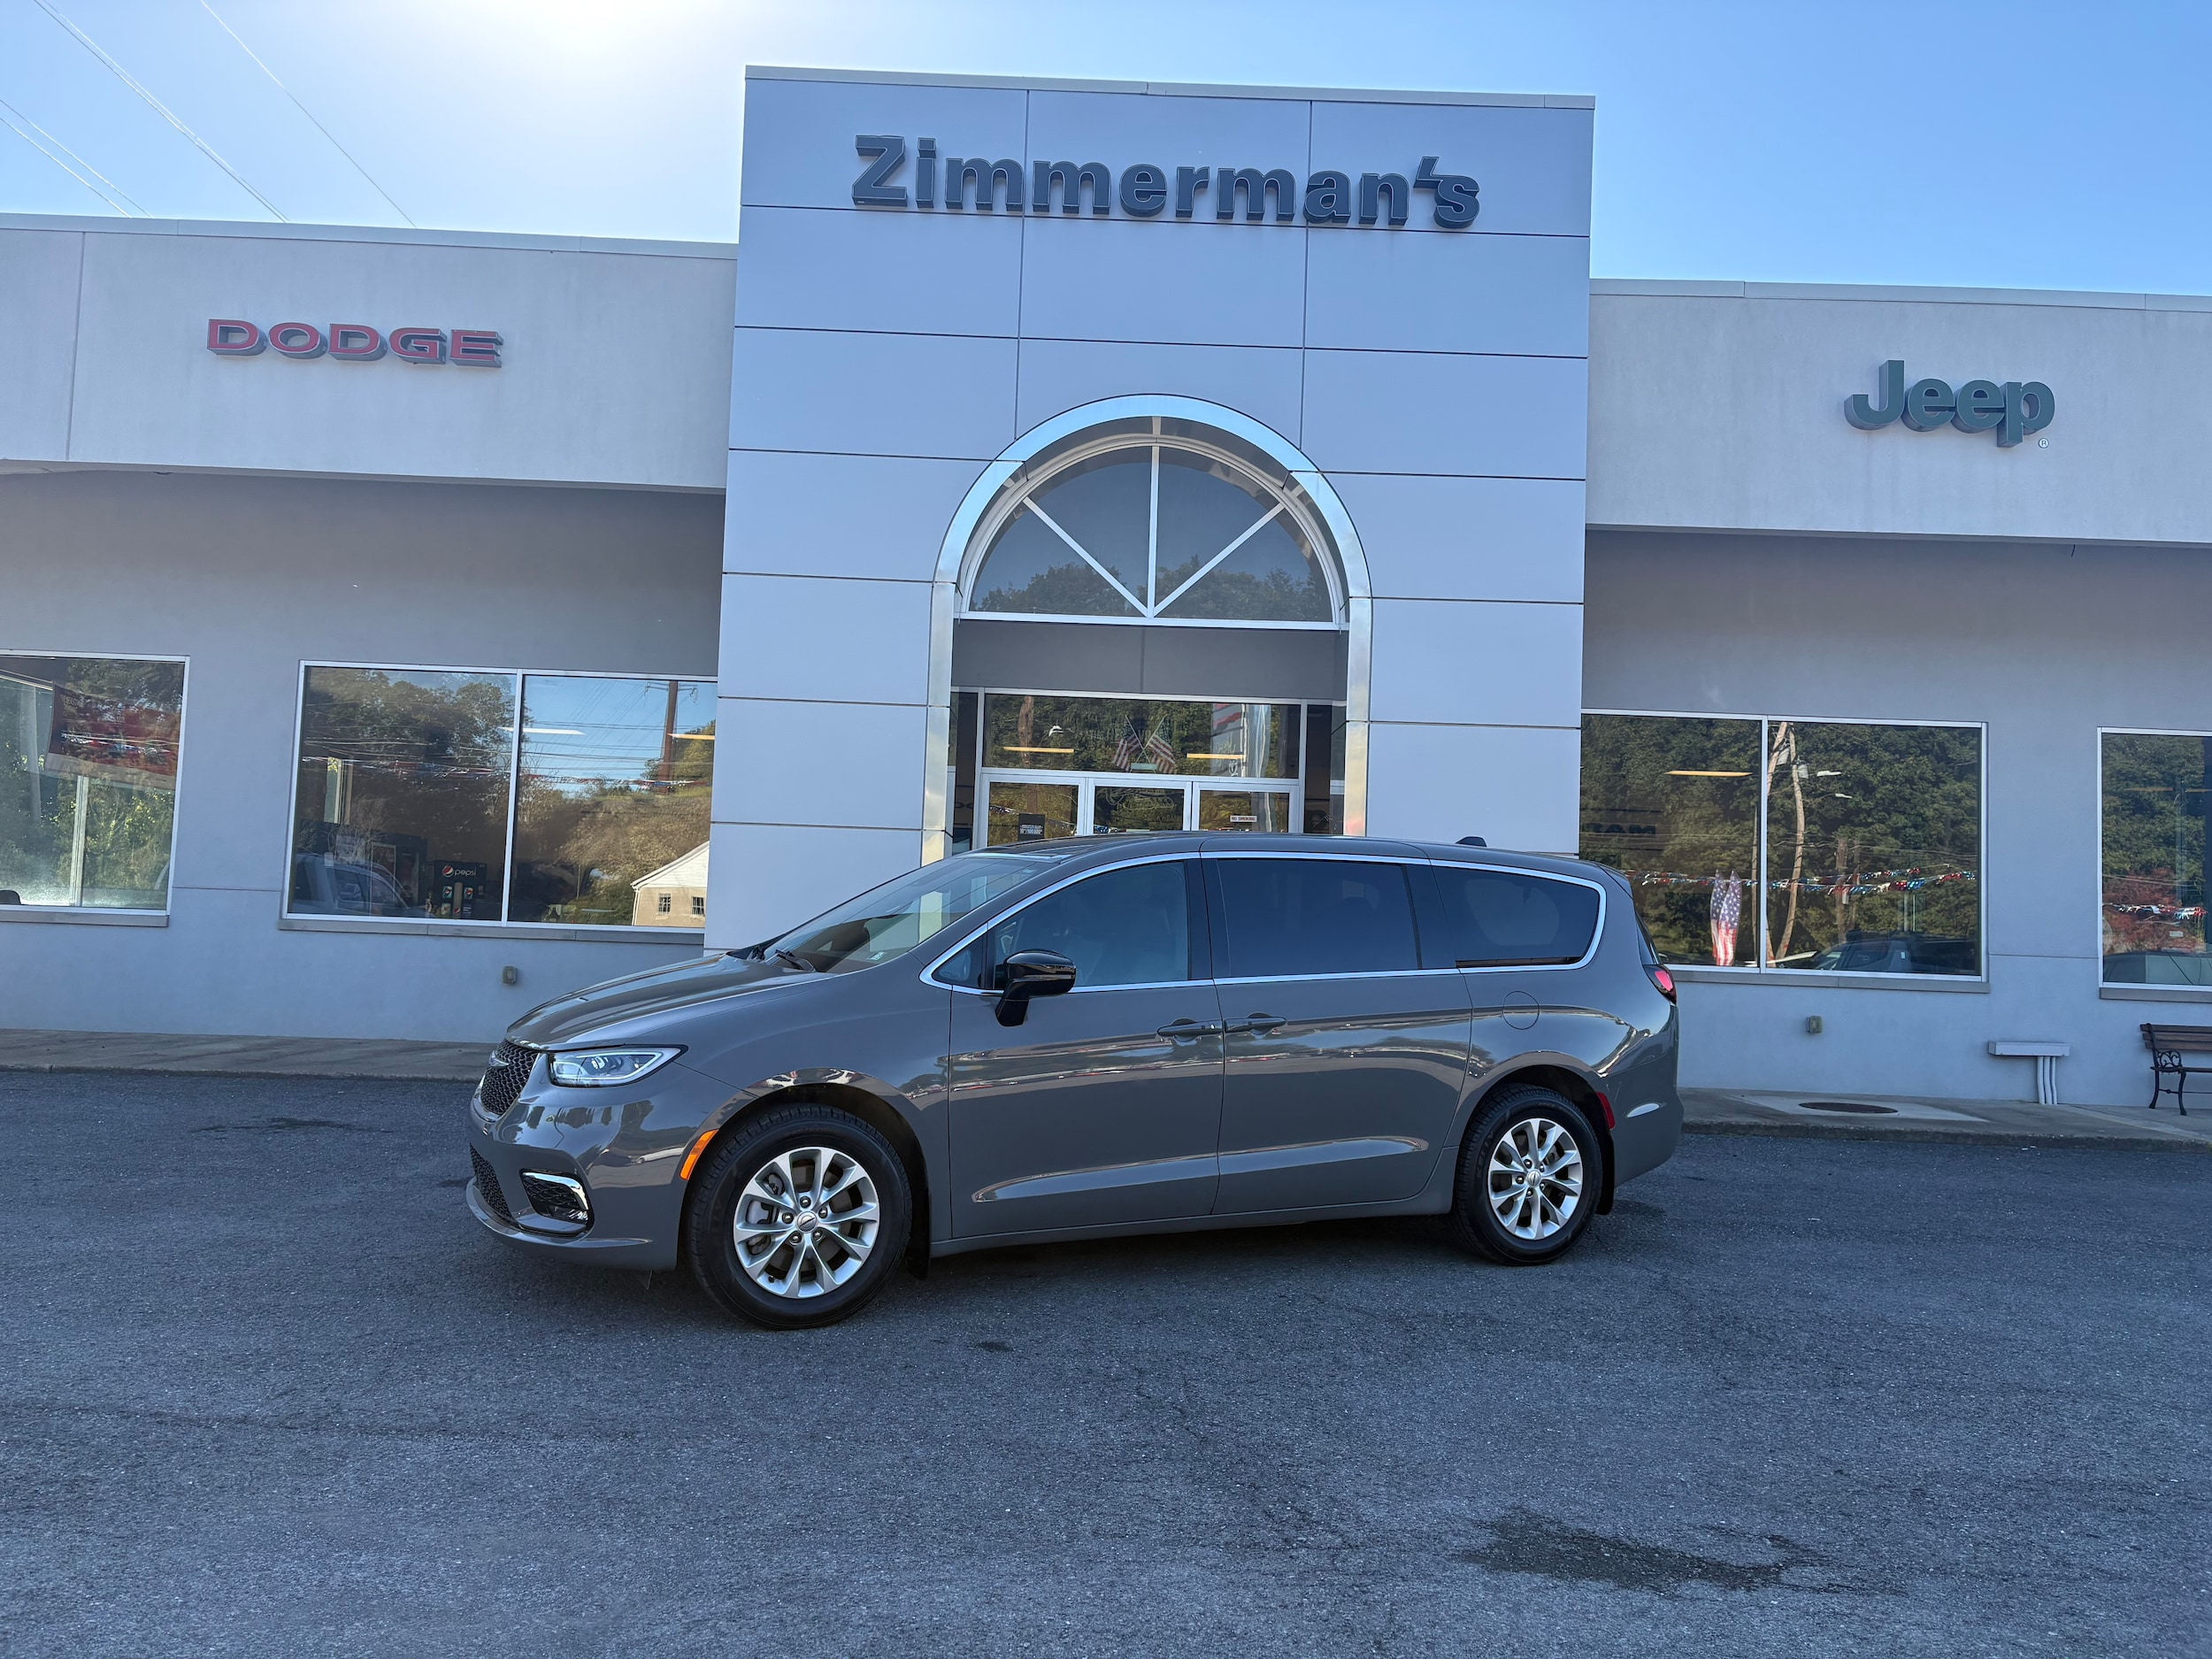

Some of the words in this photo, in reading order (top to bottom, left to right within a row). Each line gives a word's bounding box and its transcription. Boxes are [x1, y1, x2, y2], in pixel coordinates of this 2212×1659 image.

[851, 134, 1480, 229] Zimmerman's
[207, 319, 503, 368] DODGE
[1844, 359, 2055, 448] Jeep
